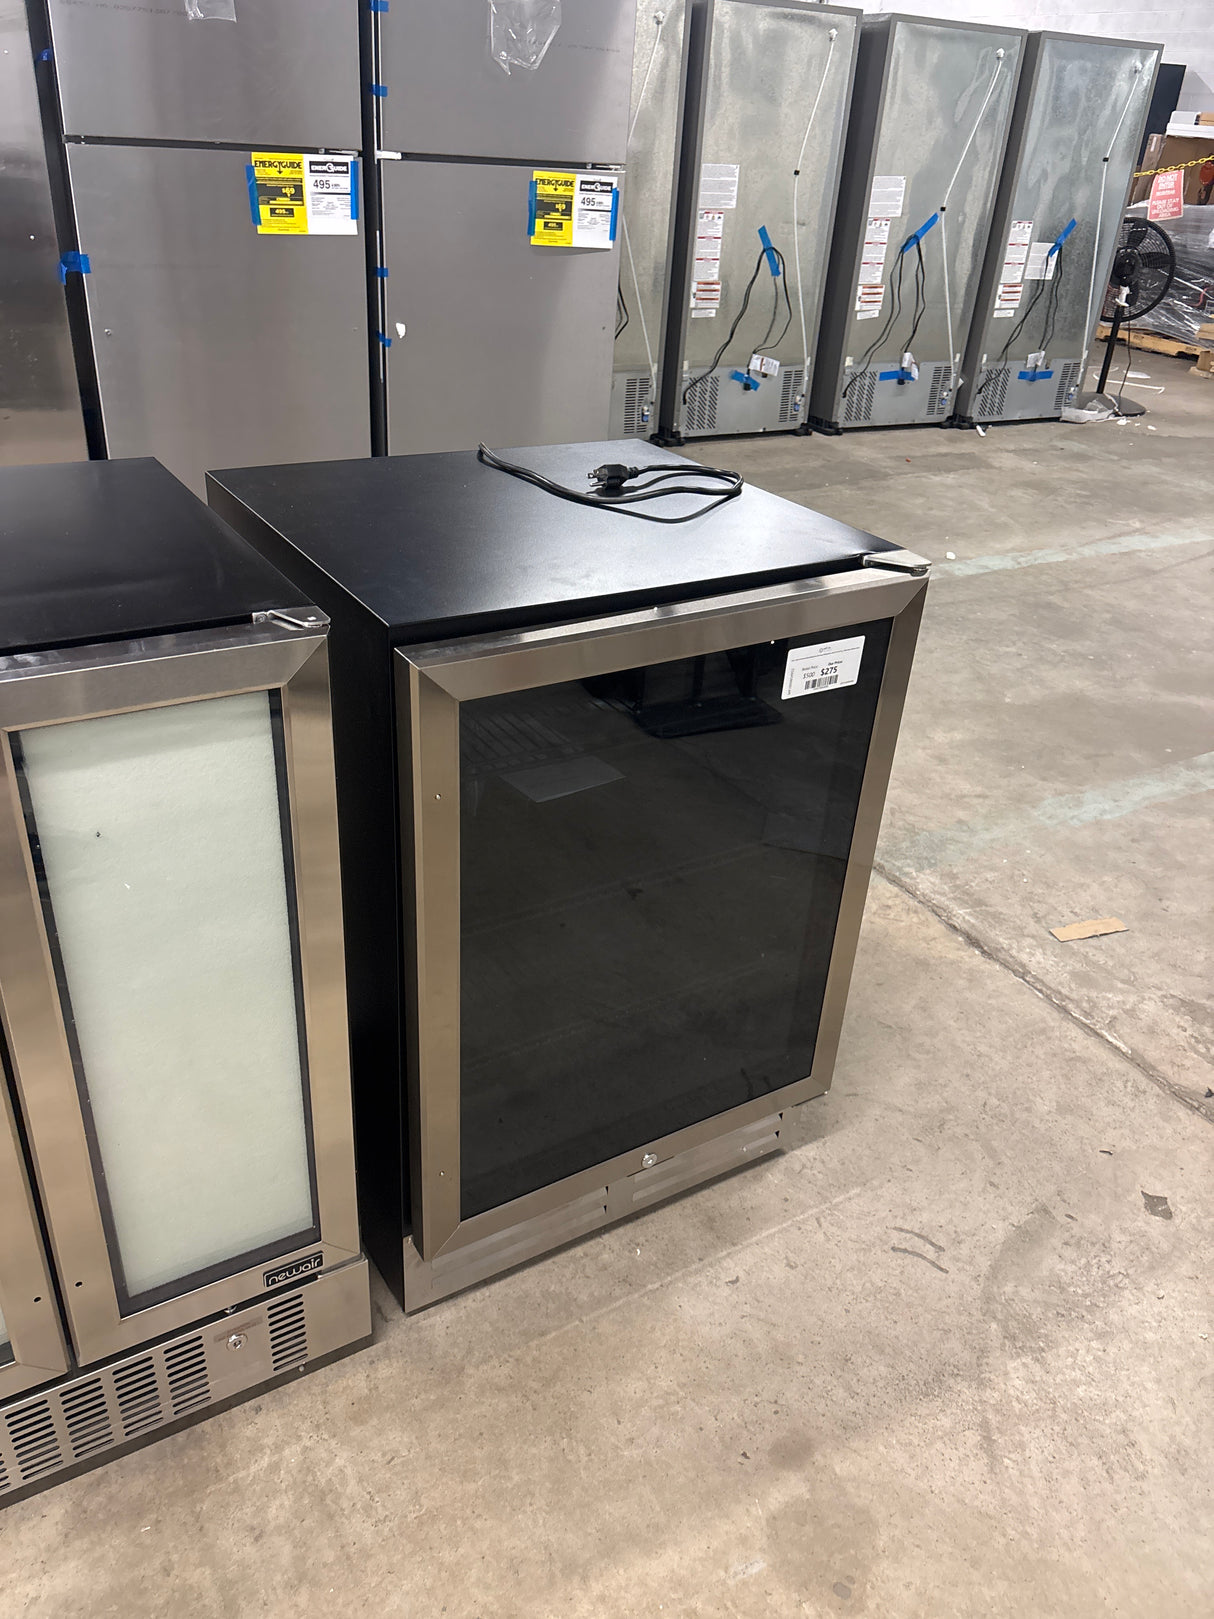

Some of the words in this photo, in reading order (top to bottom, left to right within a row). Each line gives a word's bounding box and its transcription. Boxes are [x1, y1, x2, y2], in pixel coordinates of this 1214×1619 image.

[313, 179, 331, 189] 495
[580, 196, 596, 206] 495
[820, 666, 838, 676] $275
[268, 1258, 321, 1285] newair
